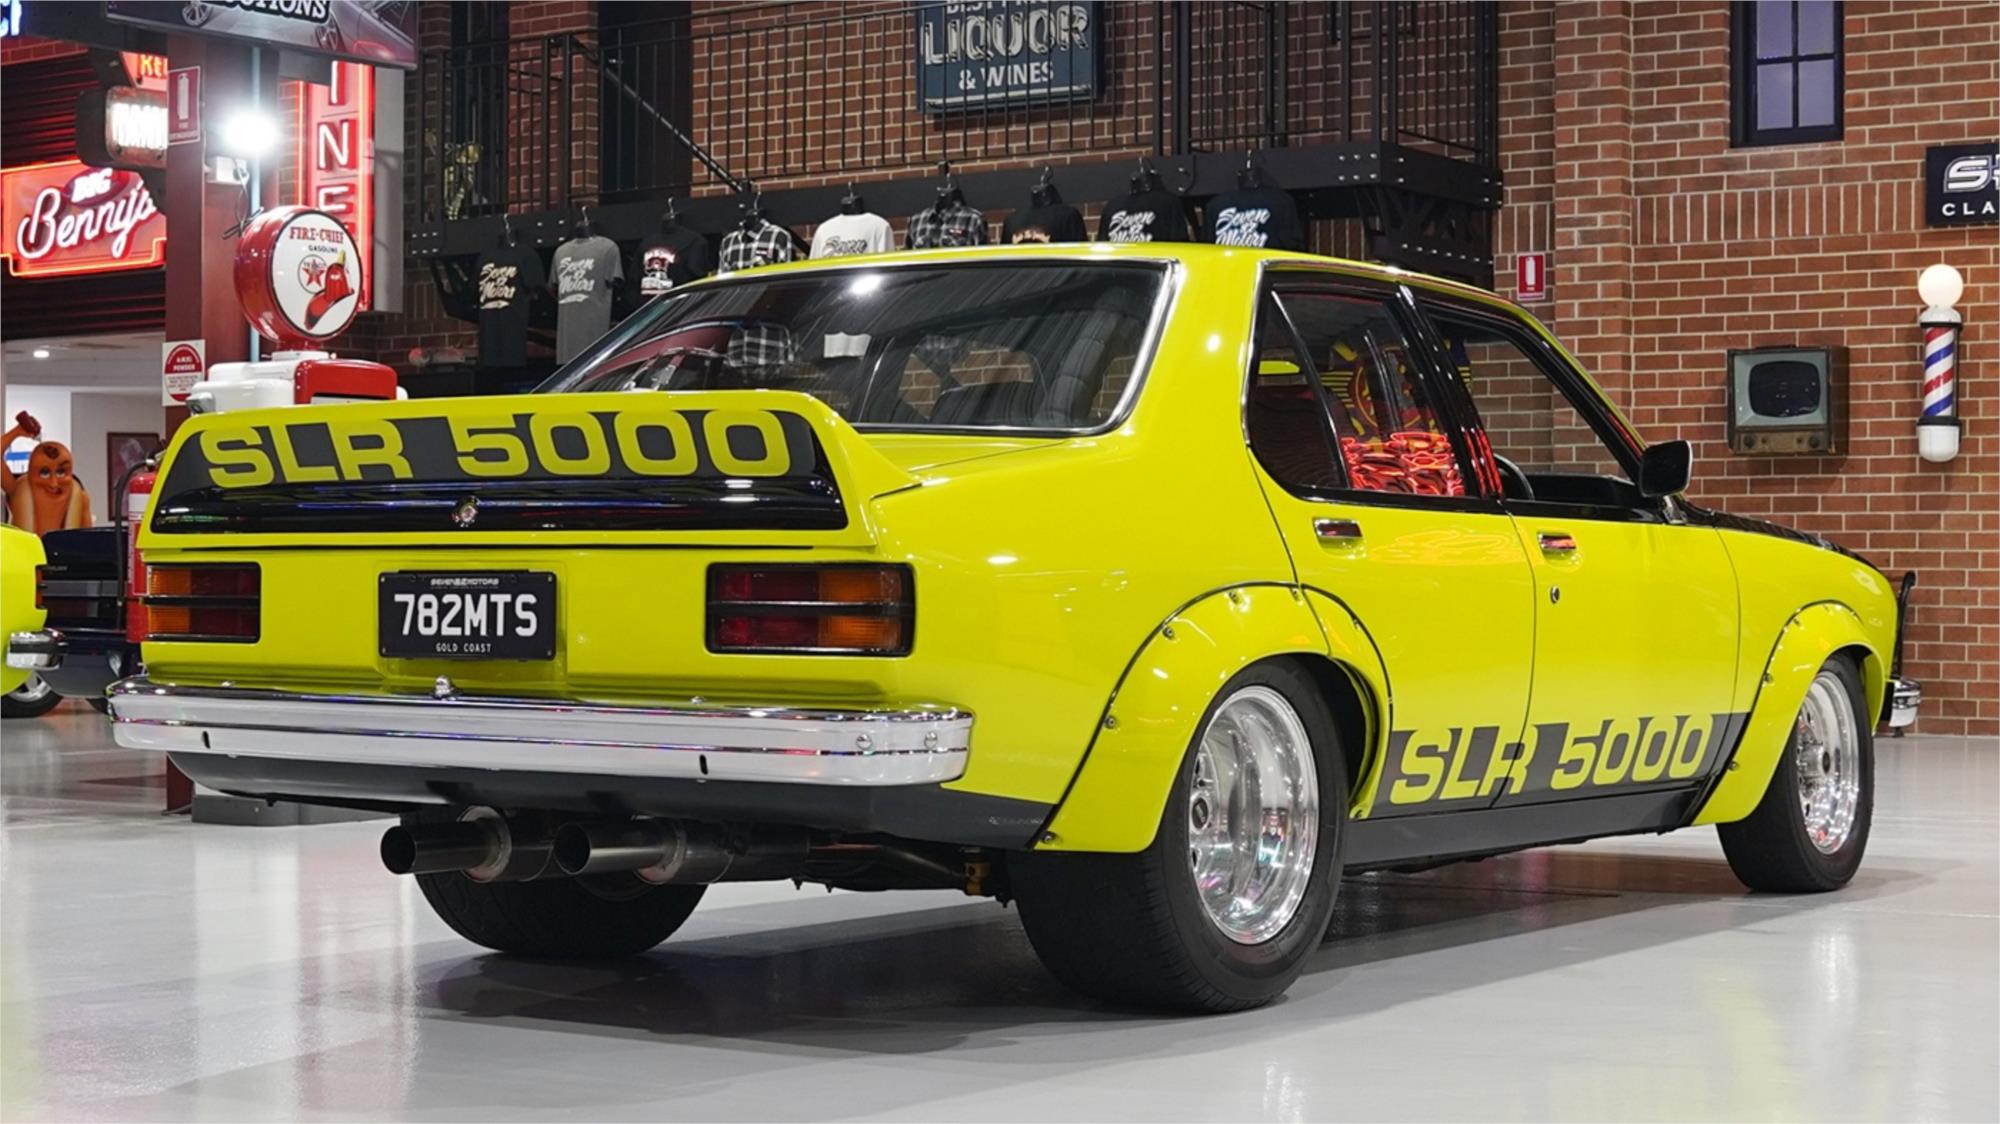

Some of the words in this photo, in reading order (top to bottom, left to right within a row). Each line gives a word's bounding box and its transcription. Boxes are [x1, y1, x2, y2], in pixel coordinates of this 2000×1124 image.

[921, 6, 1088, 65] LIQUOR
[958, 69, 976, 90] &
[981, 62, 1053, 87] WINES
[1943, 154, 2000, 193] S
[1109, 210, 1156, 236] Seven
[1216, 206, 1271, 235] Seven
[1942, 201, 1996, 216] CLA
[200, 419, 413, 488] SLR
[452, 409, 793, 477] 5000
[394, 593, 537, 637] 782MTS
[436, 643, 458, 653] GOLD
[463, 643, 492, 653] COAST
[1390, 725, 1538, 804] SLR
[1550, 712, 1713, 790] 5000
